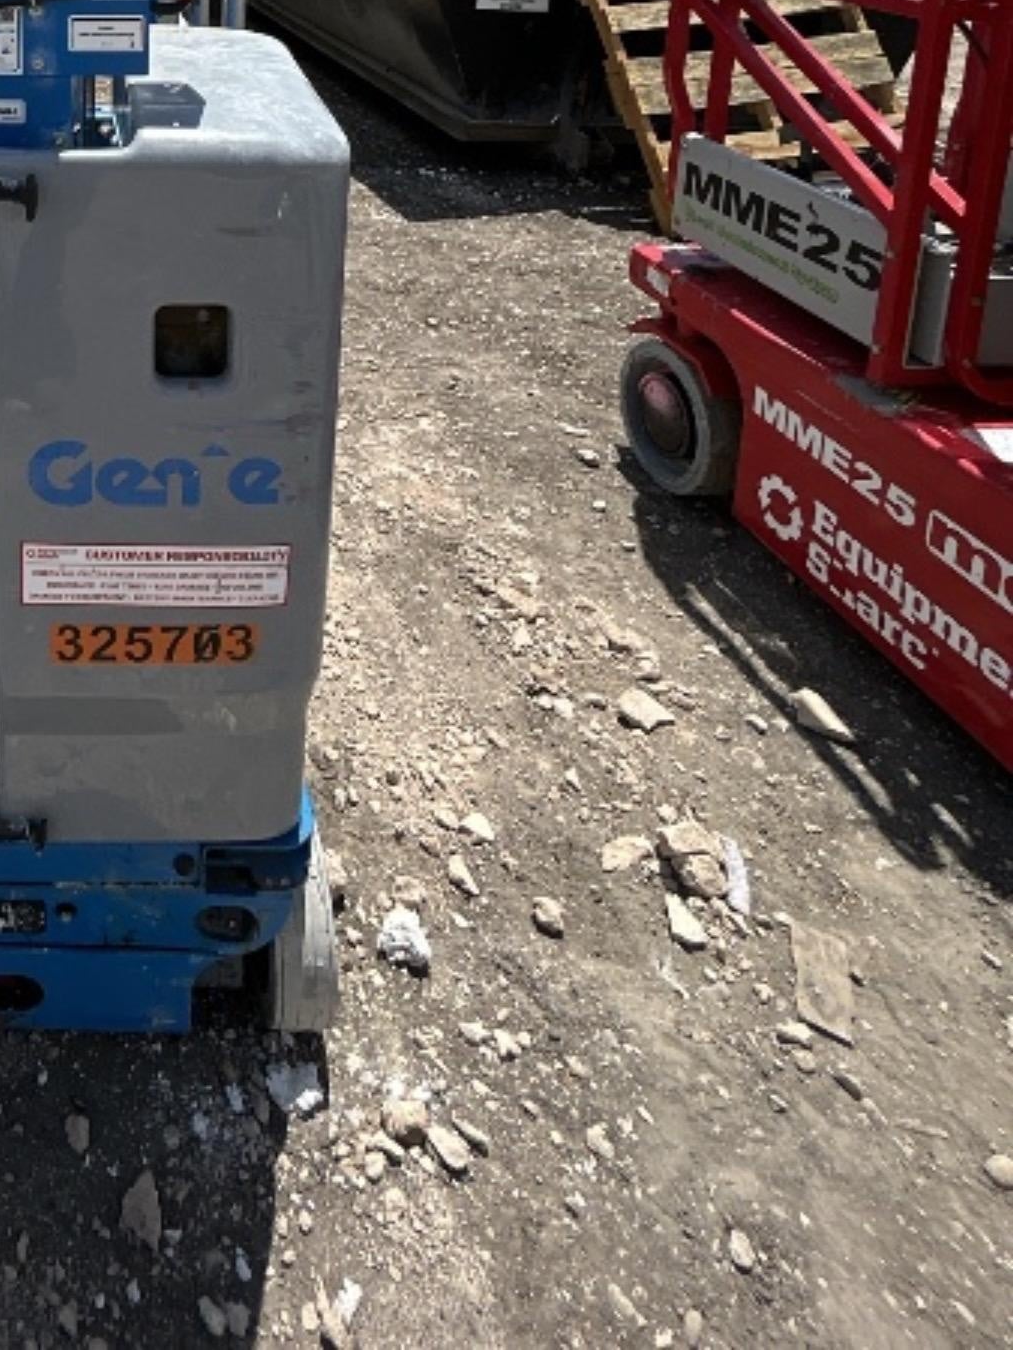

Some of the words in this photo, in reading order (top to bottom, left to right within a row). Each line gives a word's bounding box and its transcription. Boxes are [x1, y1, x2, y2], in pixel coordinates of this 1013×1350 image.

[683, 161, 884, 292] MME25
[753, 386, 917, 527] MME25
[55, 624, 254, 663] 325703
[811, 500, 1013, 700] Equipme
